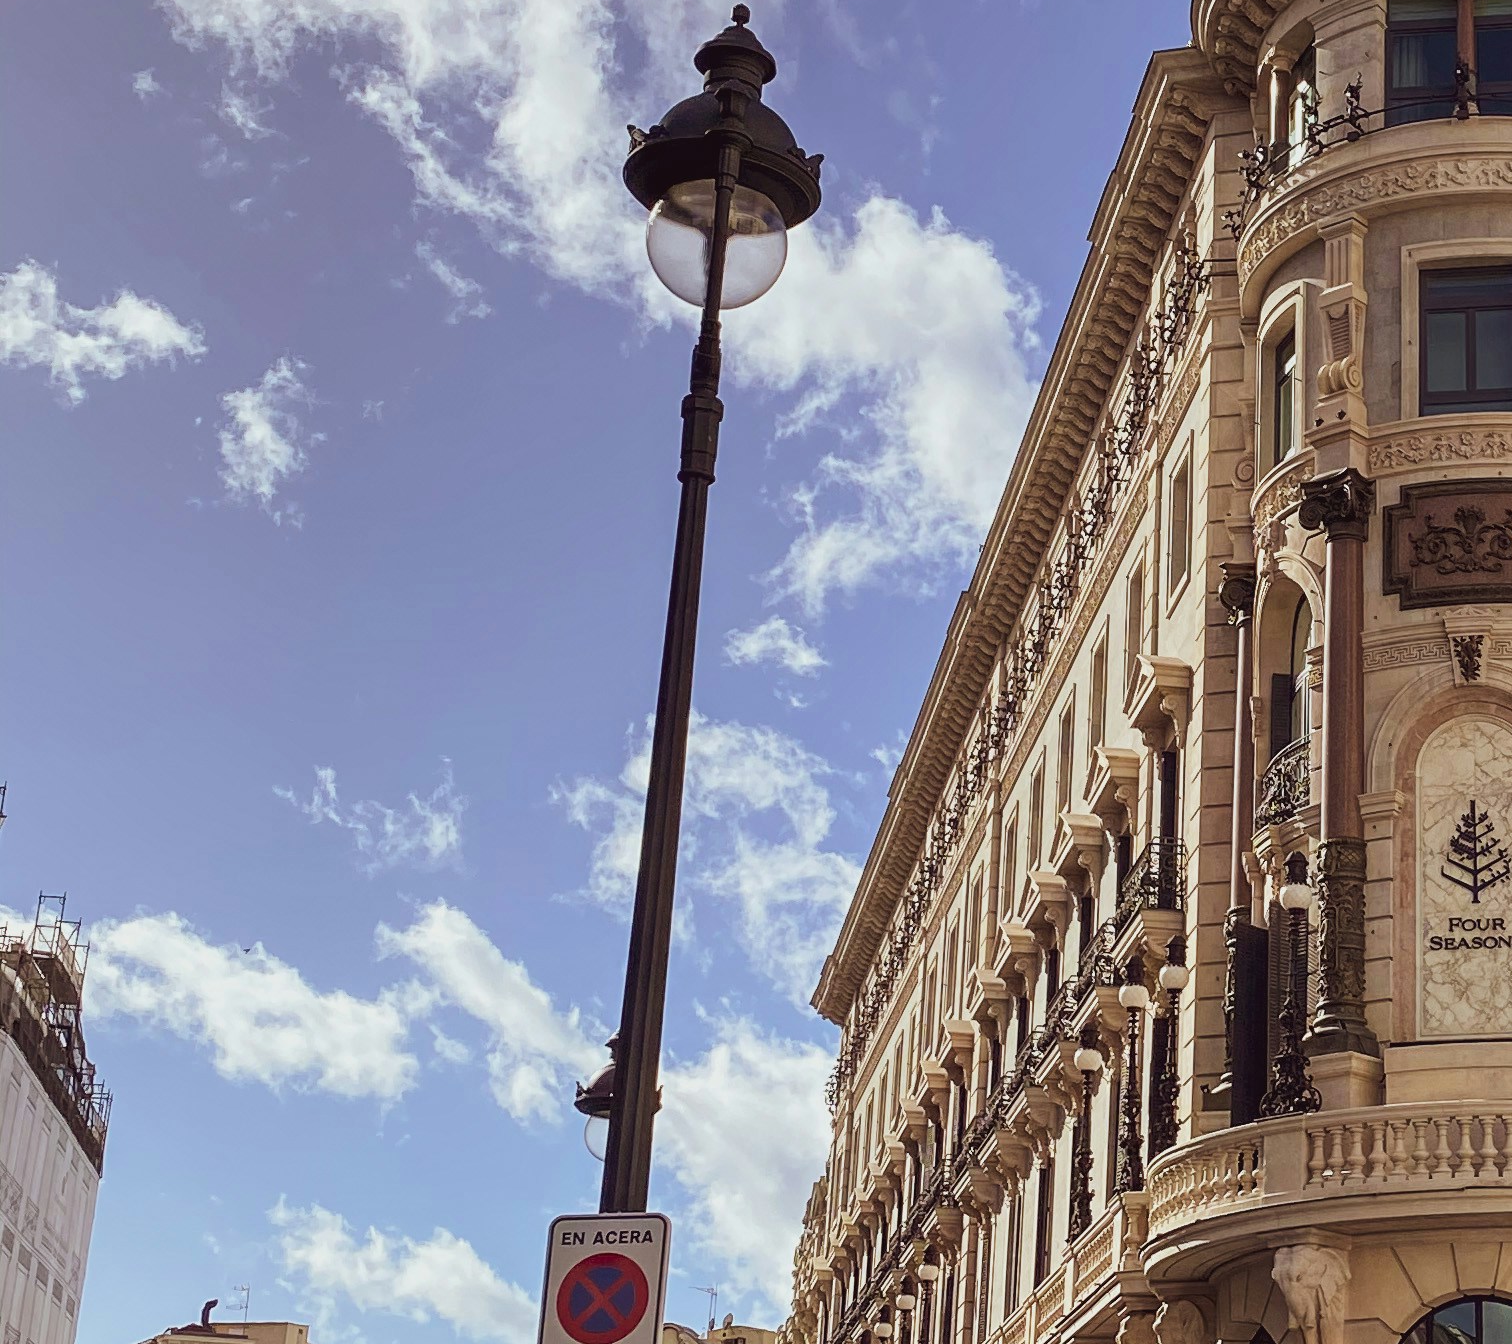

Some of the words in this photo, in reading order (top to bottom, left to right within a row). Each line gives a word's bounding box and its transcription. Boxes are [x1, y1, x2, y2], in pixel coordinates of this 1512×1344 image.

[1448, 916, 1506, 932] FOUR
[561, 1230, 585, 1246] EN
[592, 1230, 653, 1245] ACERA
